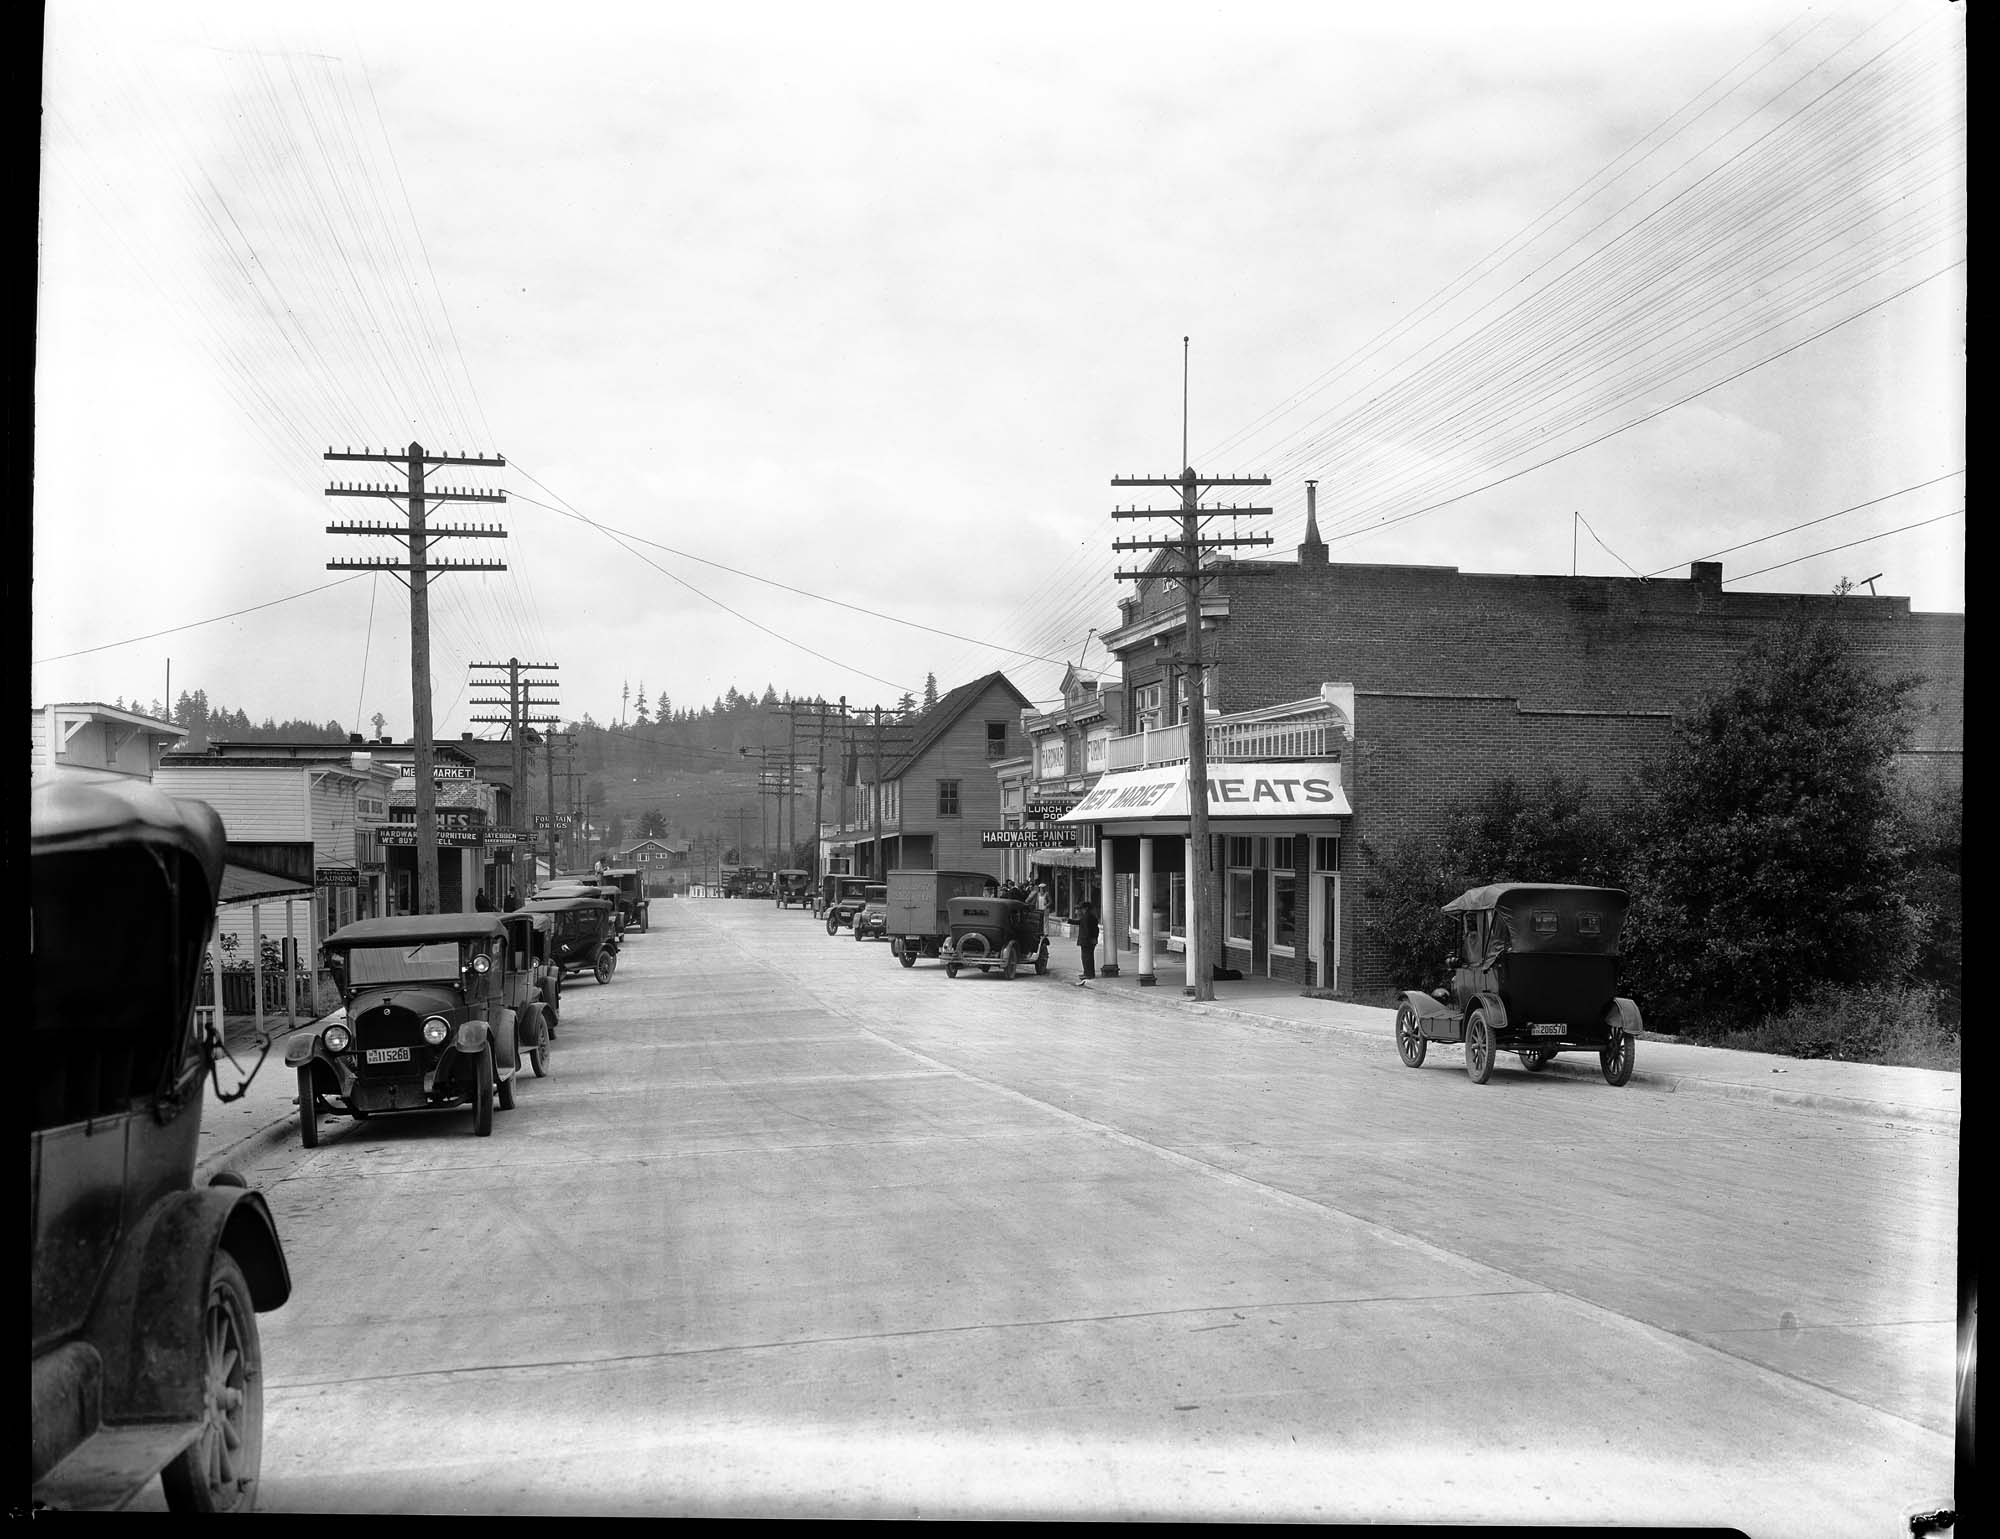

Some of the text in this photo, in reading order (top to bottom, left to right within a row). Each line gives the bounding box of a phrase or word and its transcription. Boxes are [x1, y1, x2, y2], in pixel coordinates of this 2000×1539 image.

[1108, 783, 1177, 808] MARKET
[1028, 805, 1062, 813] LUNCH
[535, 815, 572, 823] FOUTAIN
[380, 830, 417, 838] HARDWAR
[438, 838, 453, 846] ELL
[316, 874, 359, 882] LAUNDRY
[378, 1048, 409, 1062] 115268
